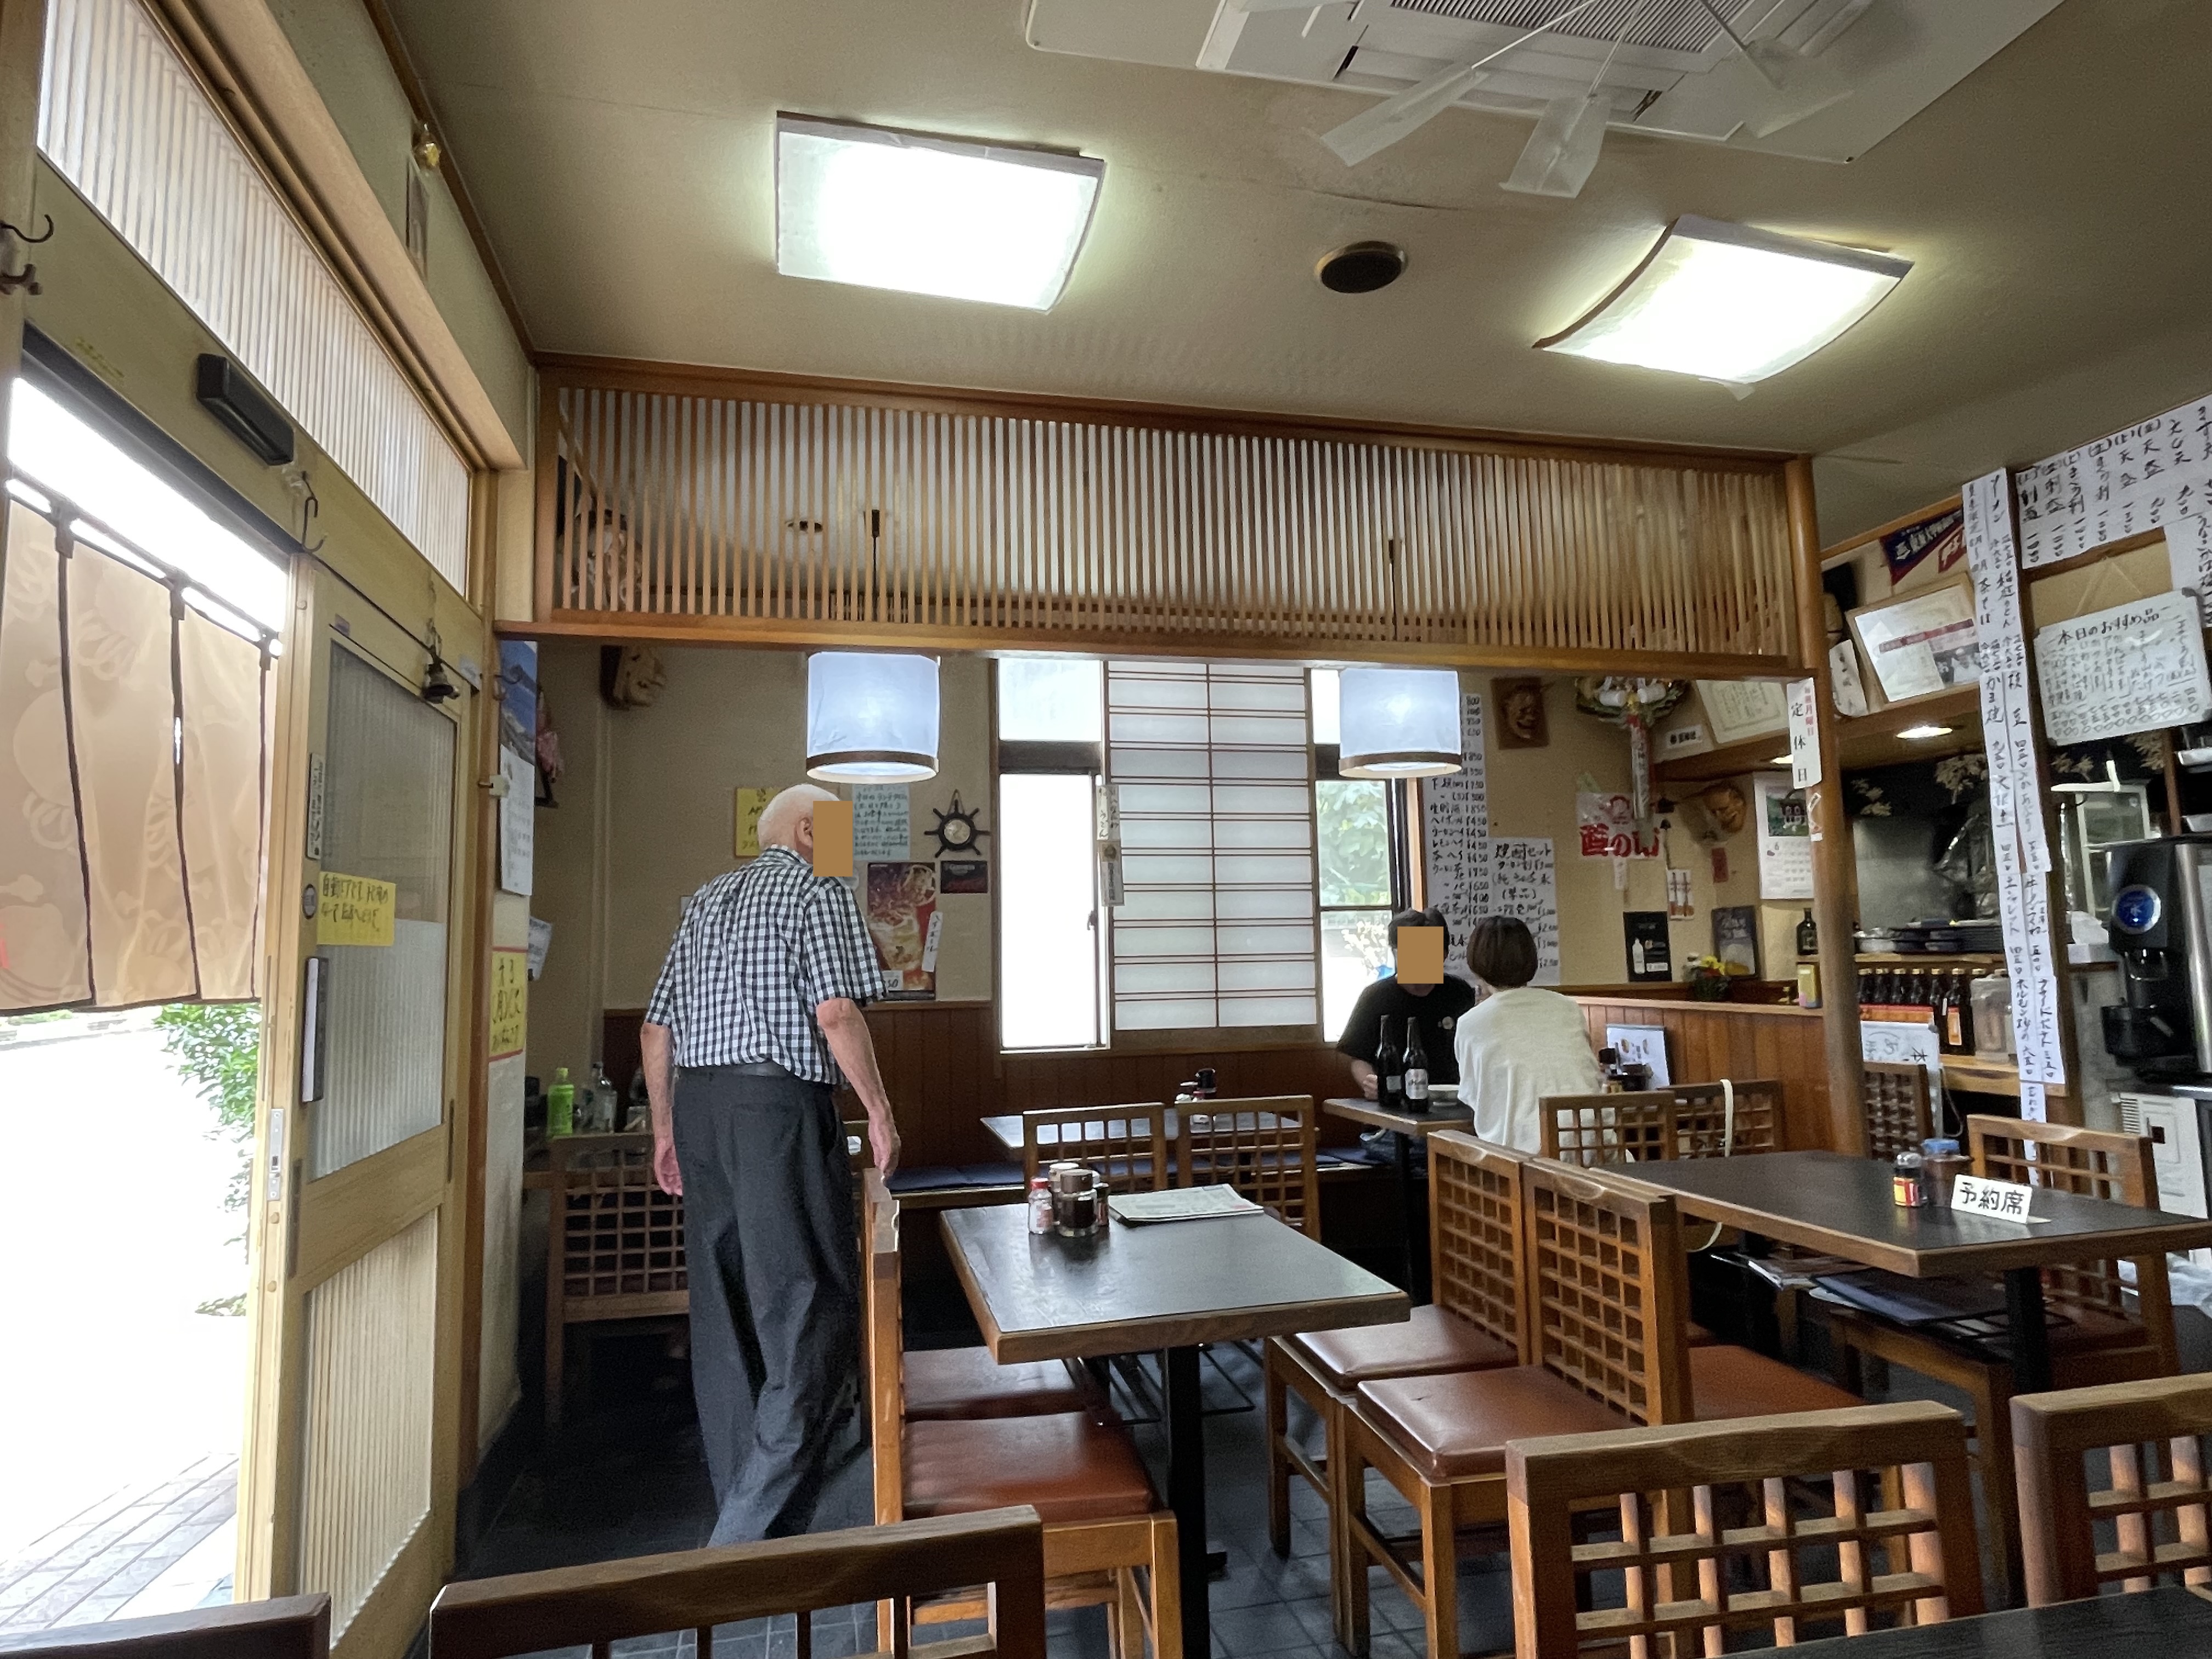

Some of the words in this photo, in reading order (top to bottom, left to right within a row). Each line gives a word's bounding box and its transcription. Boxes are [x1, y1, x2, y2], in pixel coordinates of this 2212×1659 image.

[1791, 702, 1807, 782] 定休日
[1959, 1181, 2025, 1215] 予約席
